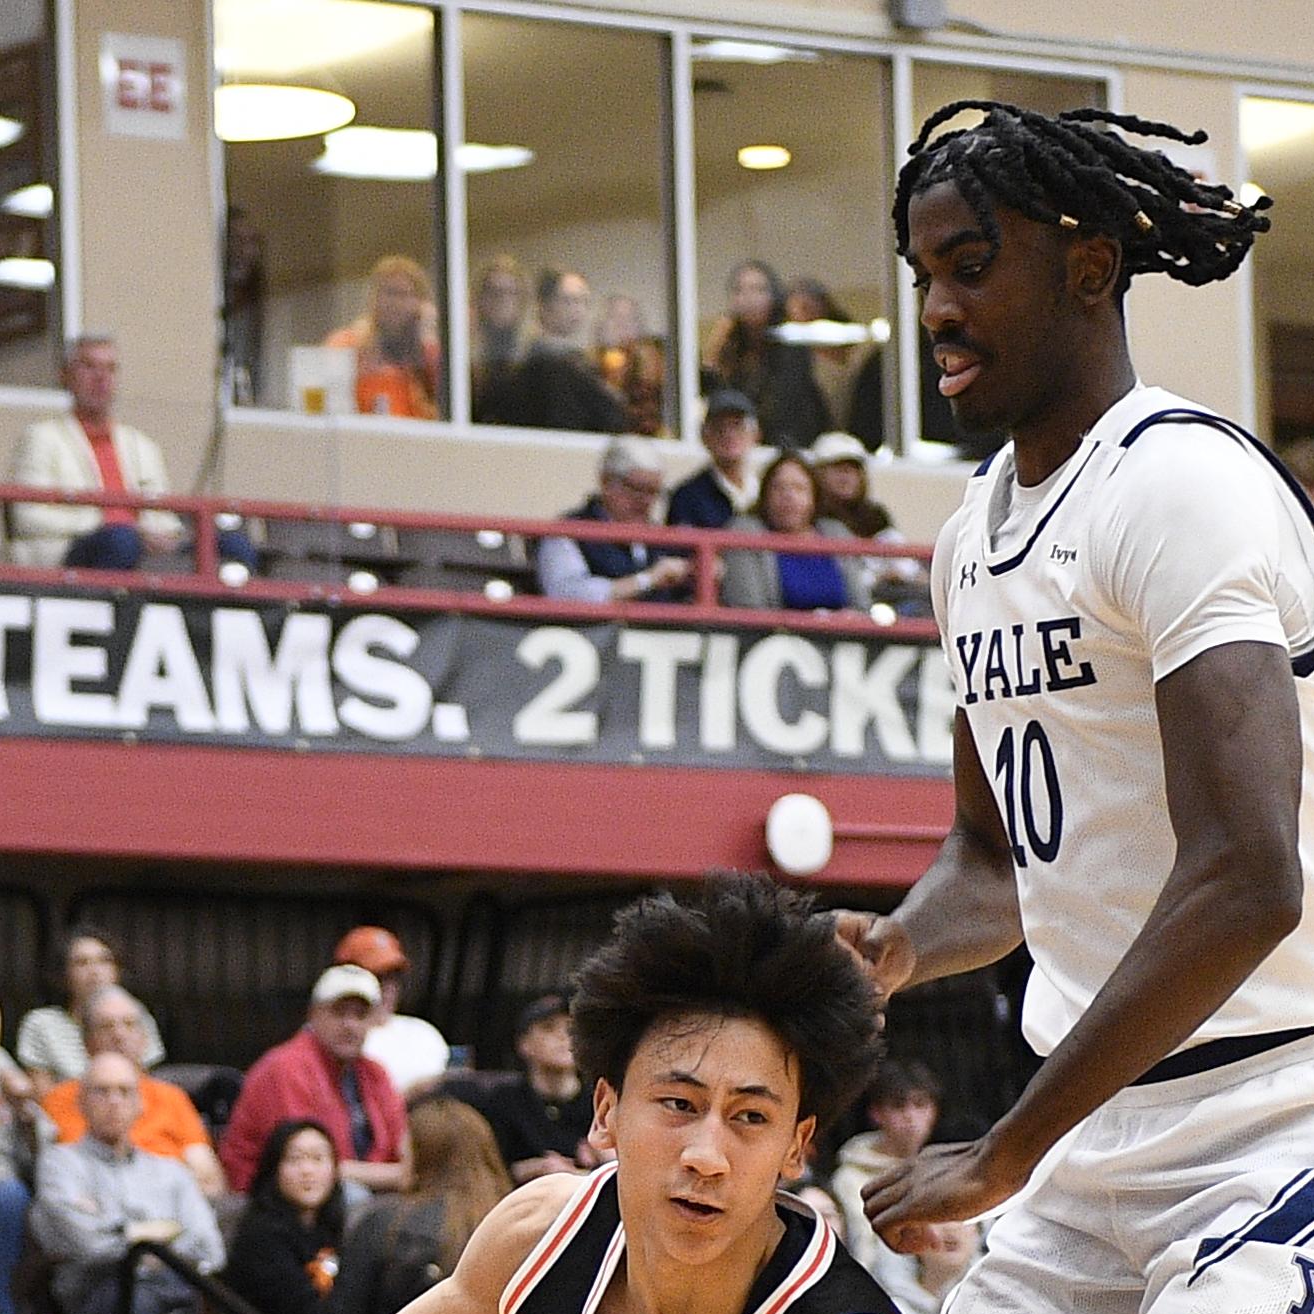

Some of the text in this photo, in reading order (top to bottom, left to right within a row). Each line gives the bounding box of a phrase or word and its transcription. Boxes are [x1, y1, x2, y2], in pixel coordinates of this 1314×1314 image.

[512, 626, 601, 744] 2
[957, 616, 1098, 706] YALE
[995, 719, 1064, 869] 10
